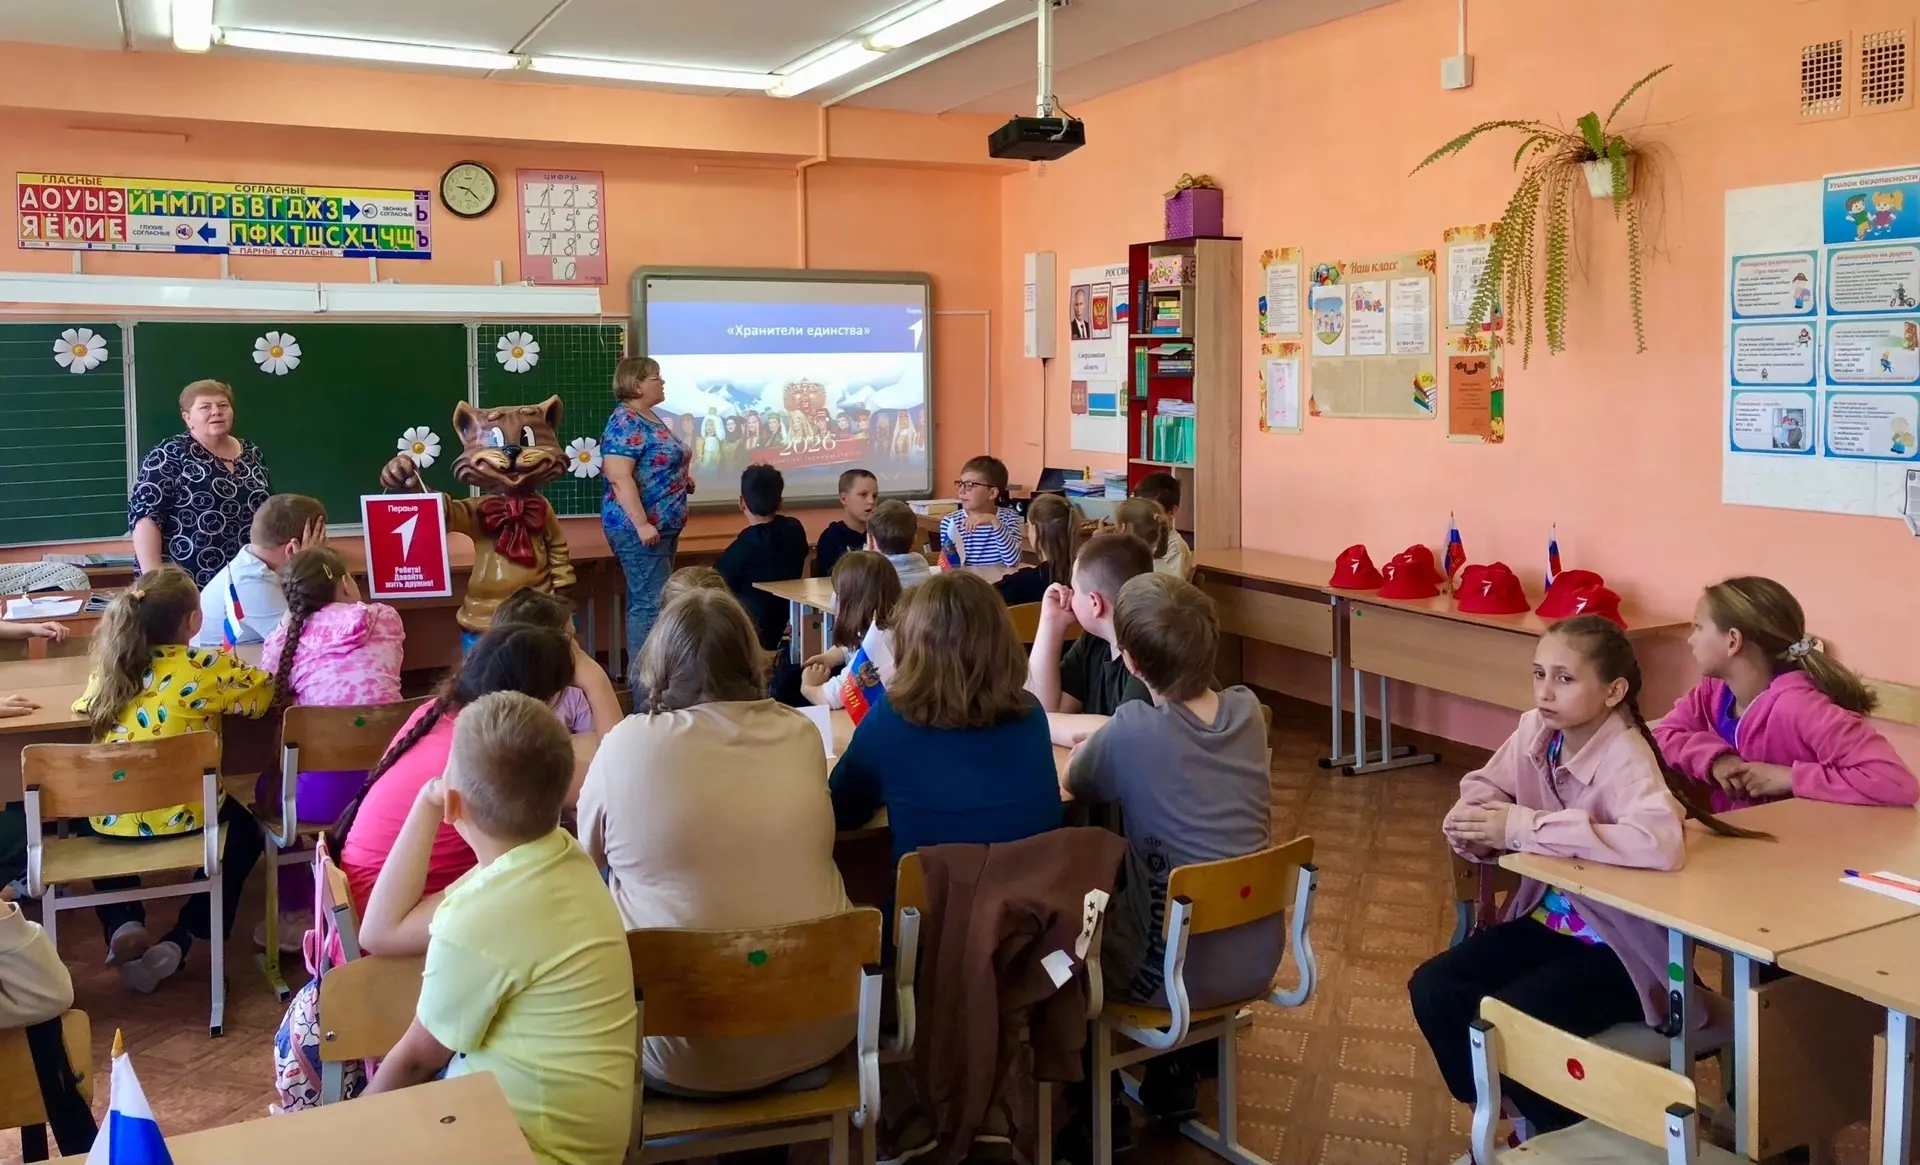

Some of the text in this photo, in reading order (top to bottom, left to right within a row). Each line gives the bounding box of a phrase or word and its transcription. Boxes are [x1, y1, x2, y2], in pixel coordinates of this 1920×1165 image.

[42, 175, 102, 186] ГЛАСНЫЕ
[544, 173, 577, 181] ЦИФРЫ
[234, 184, 306, 195] СОГЛАСНЫЕ
[1830, 181, 1858, 189] Уголок
[563, 189, 574, 208] 2
[587, 190, 598, 208] 3
[564, 213, 575, 232] 5
[587, 214, 599, 232] 6
[240, 247, 334, 257] ПАРНЫЕ СОГЛАСНЫЕ
[564, 237, 575, 256] 8
[589, 238, 599, 256] 9
[1350, 260, 1398, 274] Наш класс
[727, 323, 870, 338] «Хранители единства»
[779, 433, 837, 457] 2026
[388, 504, 418, 514] Первые
[394, 566, 421, 574] Ребята!
[394, 573, 424, 582] Давайте
[404, 580, 434, 589] дружно!
